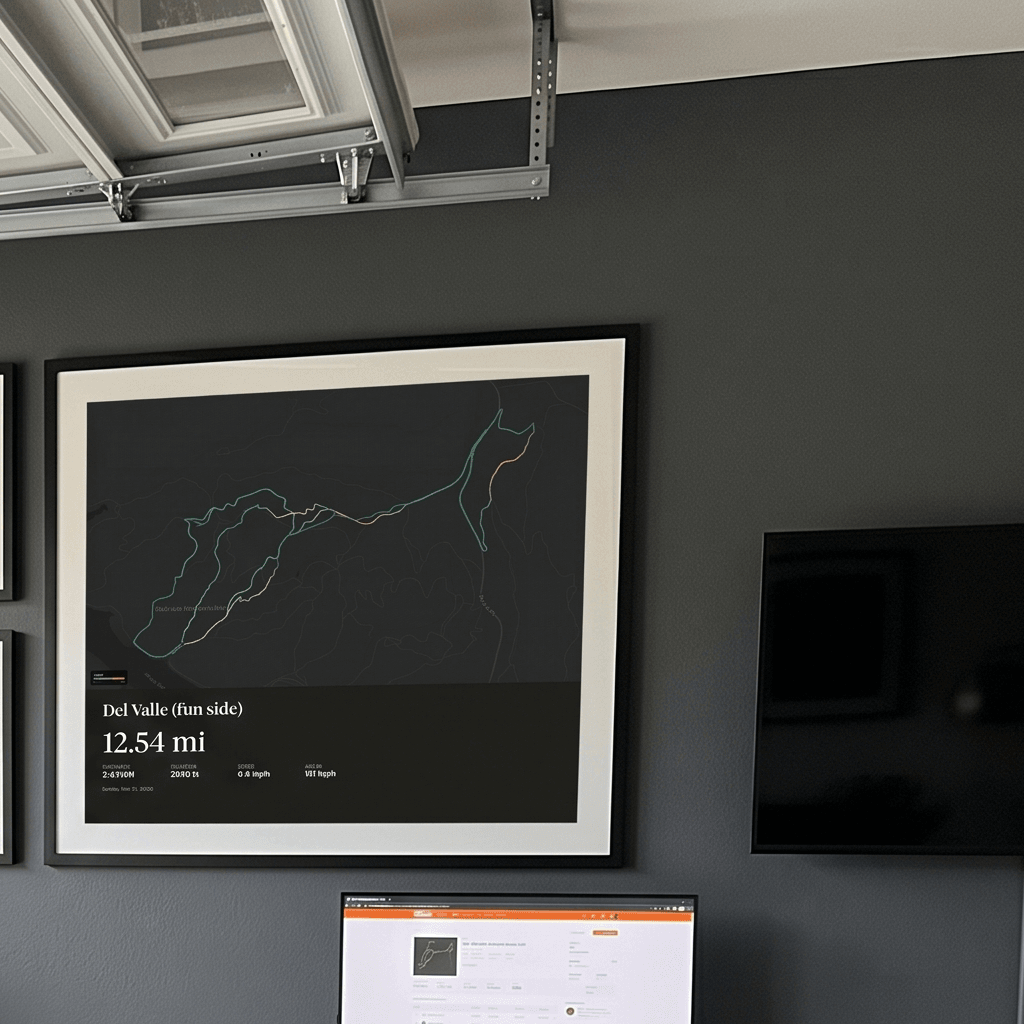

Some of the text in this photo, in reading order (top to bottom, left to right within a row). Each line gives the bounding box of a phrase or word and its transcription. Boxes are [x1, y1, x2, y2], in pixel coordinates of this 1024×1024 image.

[103, 701, 243, 718] Del Valle (fun side)
[103, 731, 206, 754] 12.54 mi
